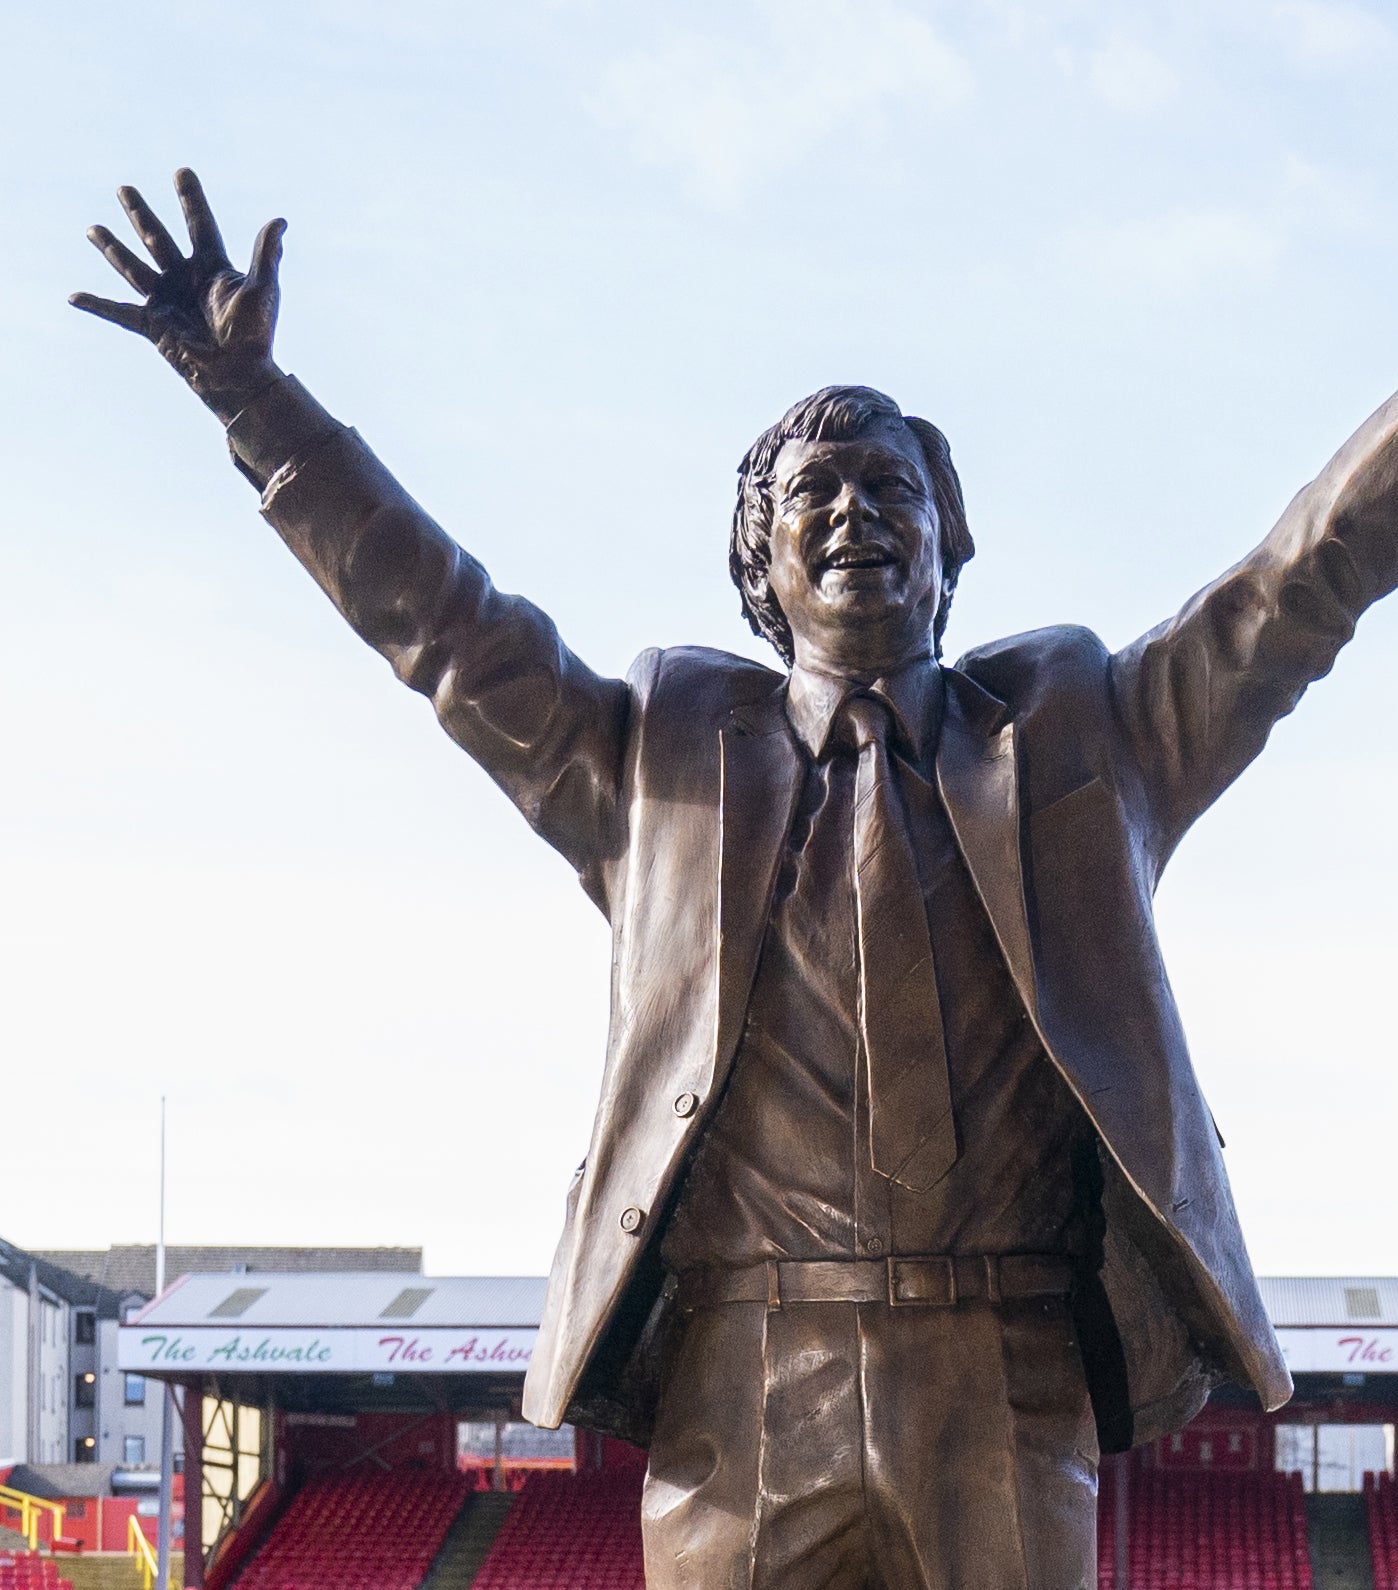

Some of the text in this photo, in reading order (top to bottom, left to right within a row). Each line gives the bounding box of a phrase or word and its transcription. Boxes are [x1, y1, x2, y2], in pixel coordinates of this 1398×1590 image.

[141, 1336, 331, 1363] The Ashvale
[379, 1337, 433, 1363] The
[1338, 1338, 1393, 1363] The
